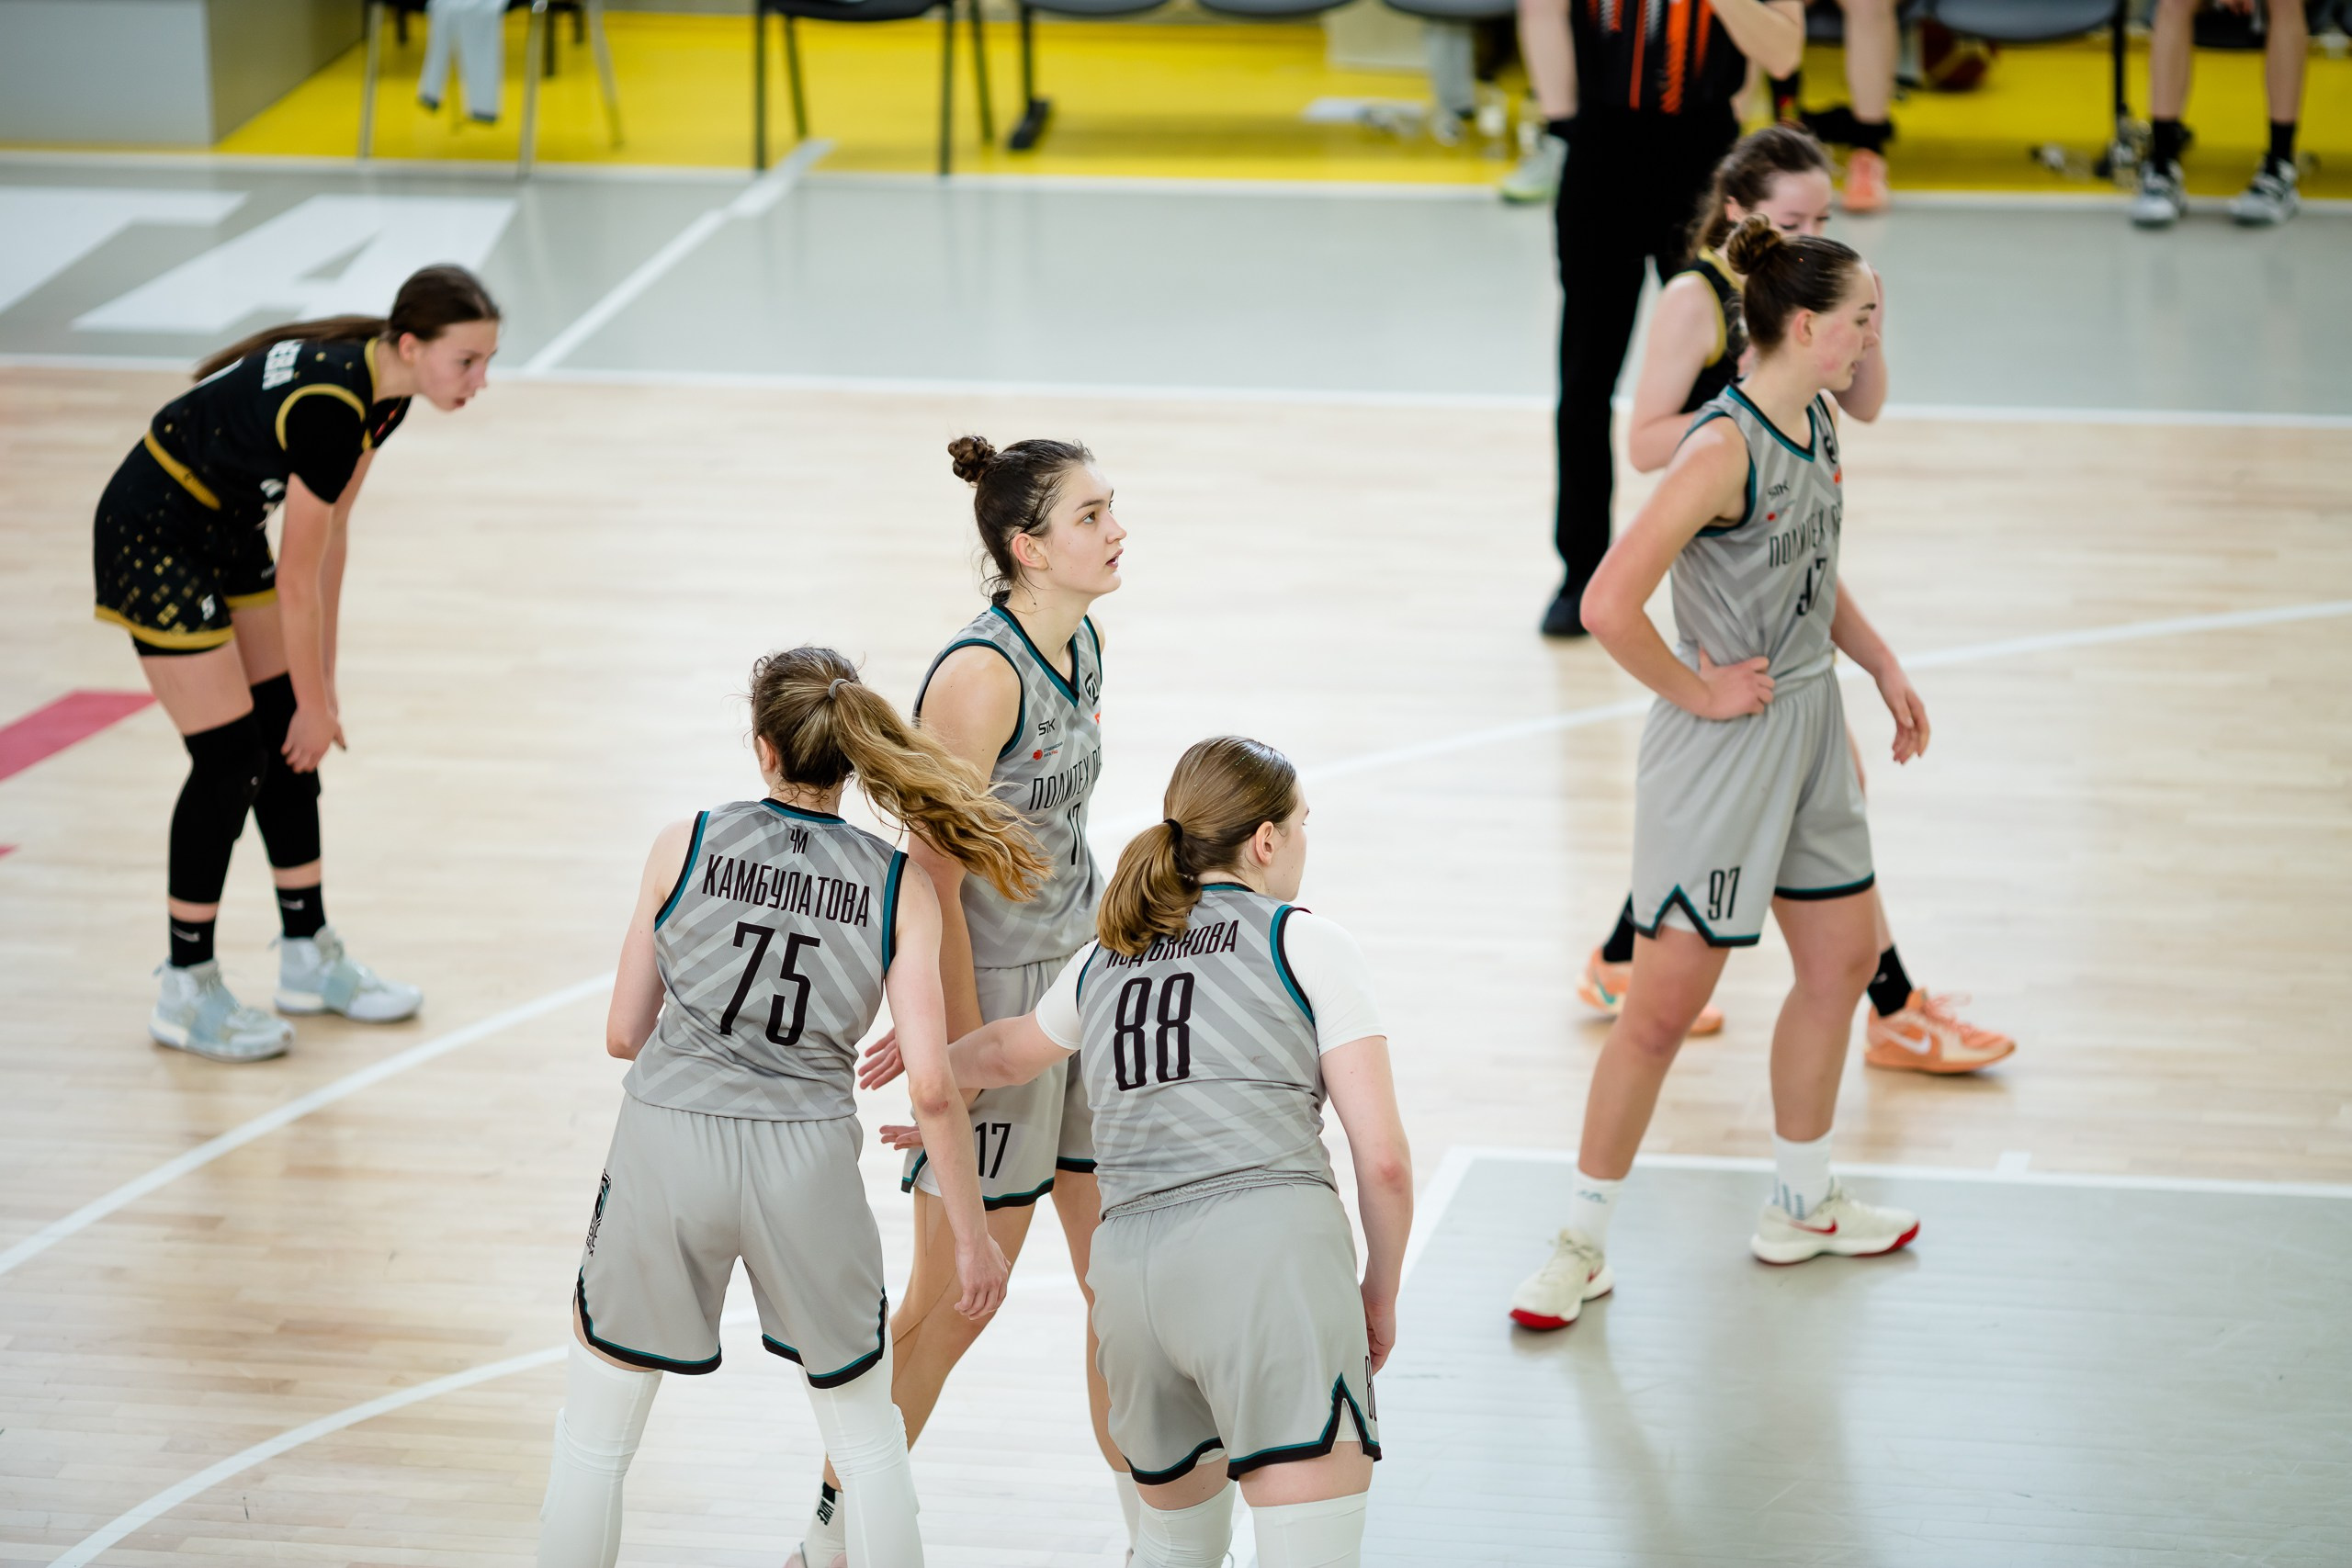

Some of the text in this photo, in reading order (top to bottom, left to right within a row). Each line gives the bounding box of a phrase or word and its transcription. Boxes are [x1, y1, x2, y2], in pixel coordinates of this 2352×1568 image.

[1037, 717, 1056, 736] STK
[1028, 758, 1090, 811] ПОЛИТЕХ
[1067, 802, 1082, 866] 17
[701, 853, 871, 928] КАМБУЛАТОВА
[1707, 864, 1741, 920] 97
[719, 921, 821, 1047] 75
[1114, 972, 1195, 1092] 88
[975, 1122, 1012, 1179] 17
